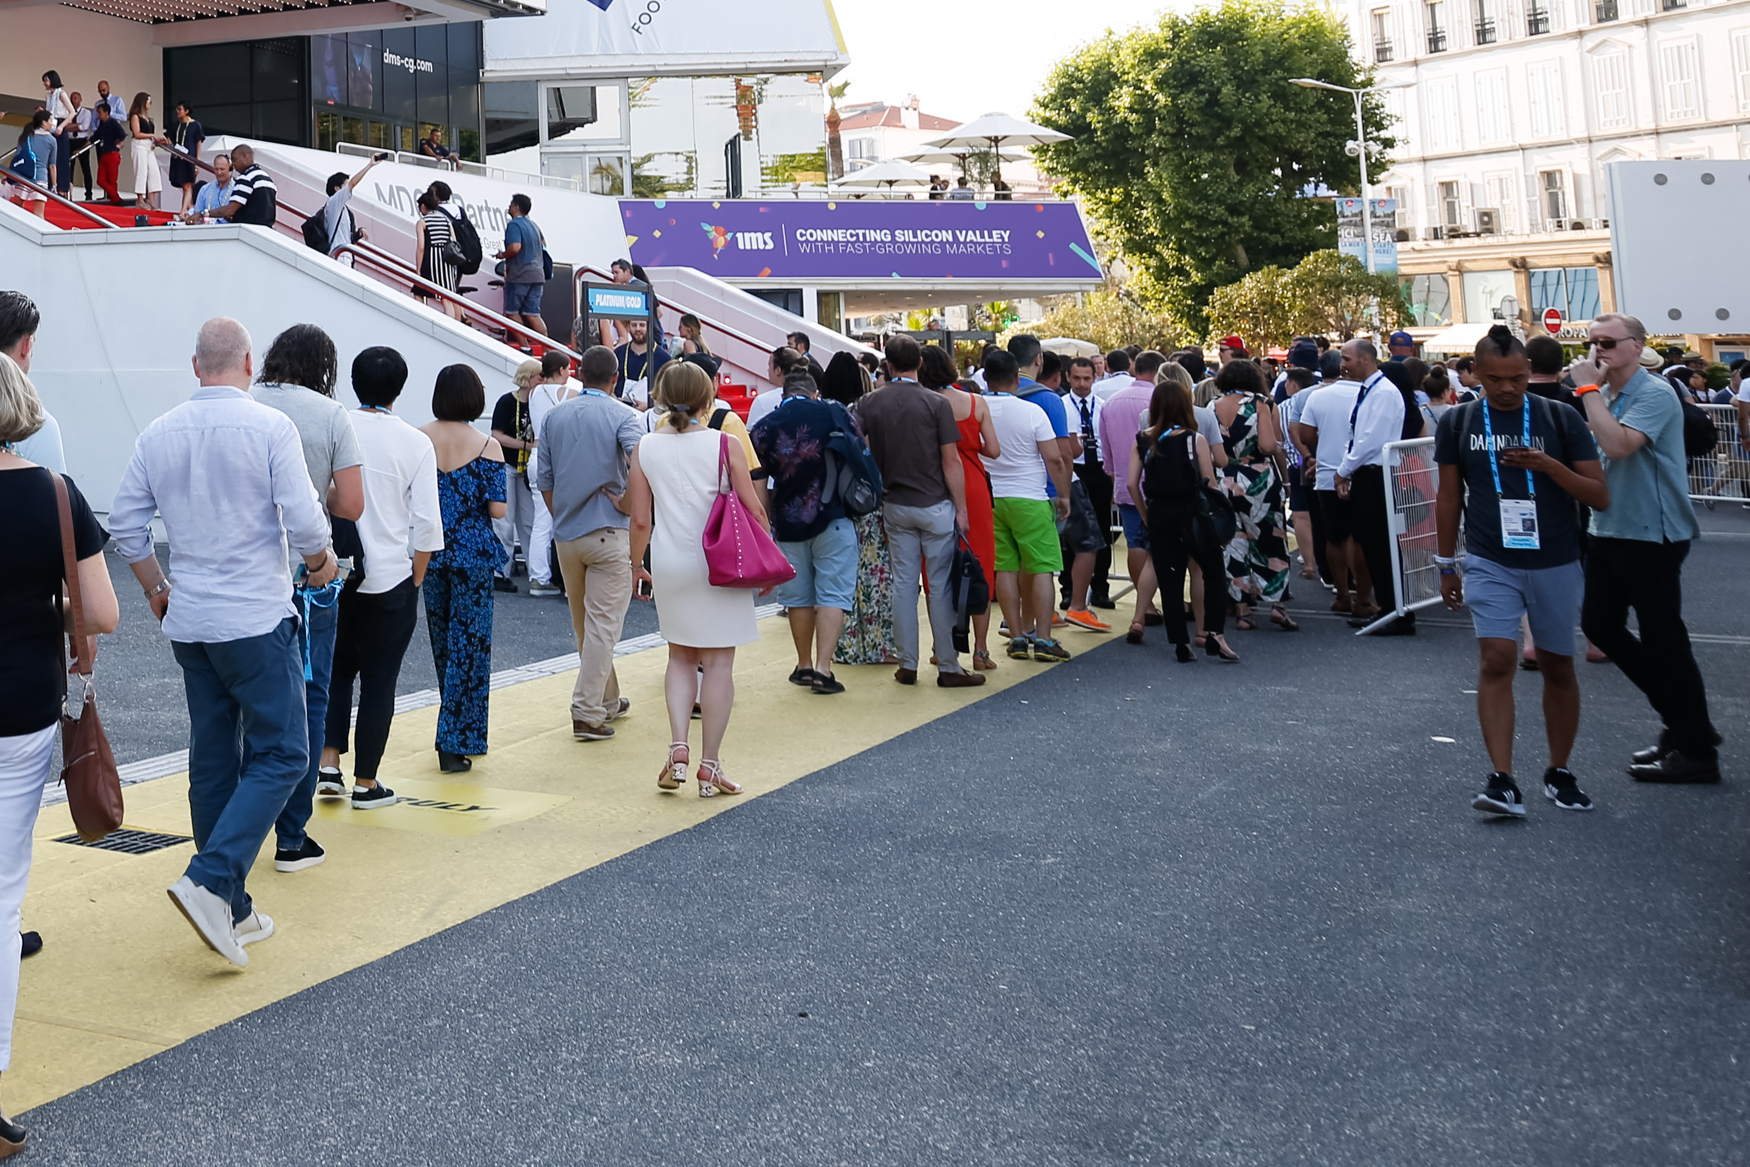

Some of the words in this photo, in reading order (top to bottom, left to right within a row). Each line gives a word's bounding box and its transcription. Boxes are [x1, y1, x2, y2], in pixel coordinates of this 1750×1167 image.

[383, 48, 434, 74] dms-cg.com
[796, 229, 892, 242] CONNECTING
[894, 229, 953, 242] SILICON
[954, 230, 1011, 243] VALLEY
[1372, 233, 1393, 243] SEA
[798, 242, 834, 254] WITH
[838, 242, 942, 254] FAST-GROWING
[946, 243, 1012, 255] MARKETS
